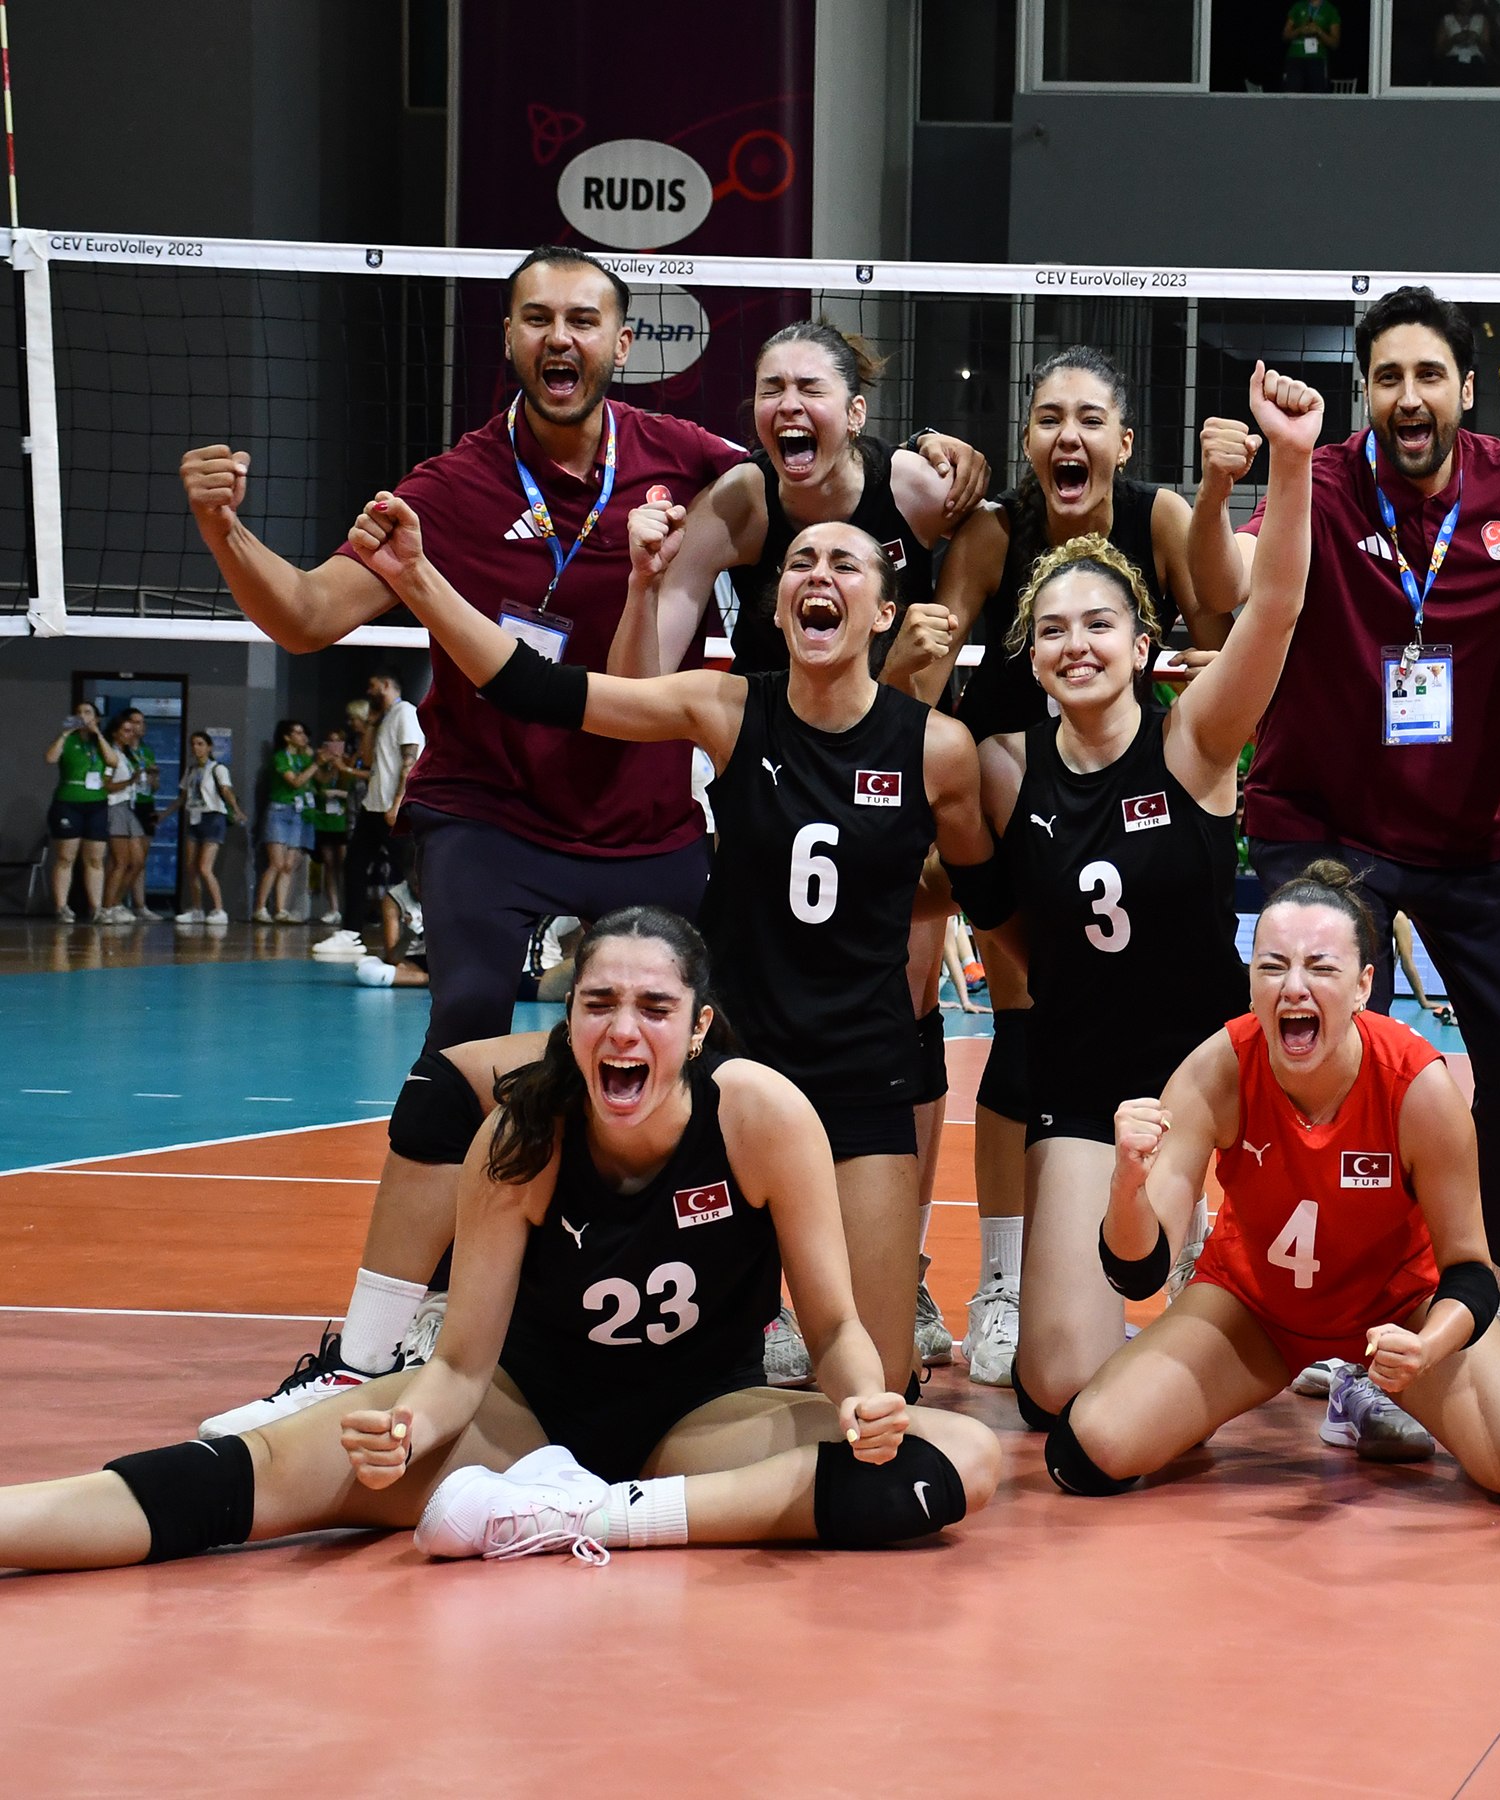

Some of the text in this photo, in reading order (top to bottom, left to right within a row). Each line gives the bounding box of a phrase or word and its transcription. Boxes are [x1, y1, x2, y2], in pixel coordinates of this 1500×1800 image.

[583, 176, 687, 213] RUDIS
[50, 236, 203, 258] CEV EuroVolley 2023
[659, 260, 694, 275] 2023
[1035, 271, 1187, 290] CEV EuroVolley 2023
[625, 317, 695, 342] han
[865, 796, 890, 804] TUR
[1136, 817, 1160, 828] TUR
[789, 822, 840, 925] 6
[1078, 860, 1131, 953] 3
[1352, 1178, 1380, 1186] TUR
[690, 1210, 720, 1224] TUR
[1267, 1199, 1321, 1289] 4
[582, 1261, 700, 1346] 23
